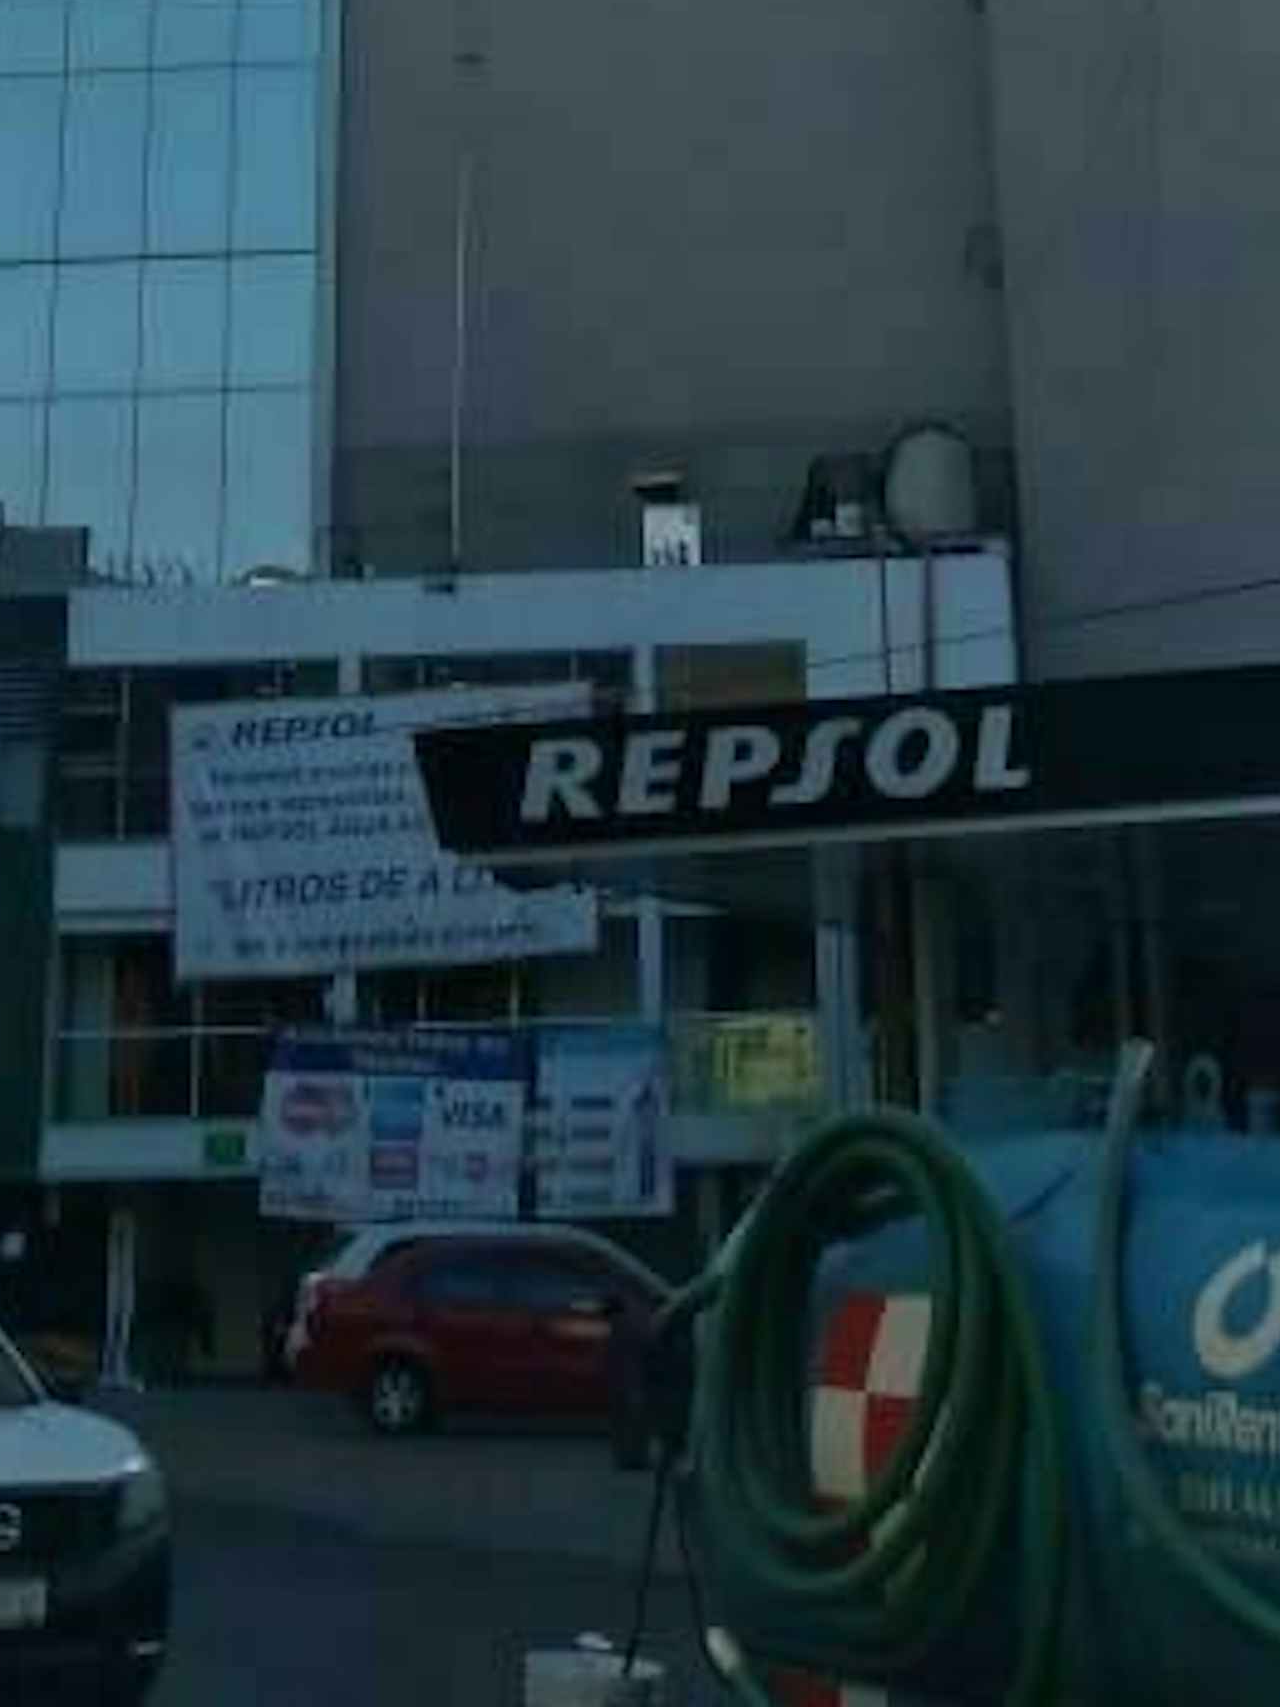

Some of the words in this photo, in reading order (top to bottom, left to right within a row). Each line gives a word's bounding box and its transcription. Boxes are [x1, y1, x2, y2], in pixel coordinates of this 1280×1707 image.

[232, 710, 375, 748] REPSOL
[521, 704, 1032, 823] REPSOL
[358, 866, 410, 900] DE
[417, 864, 441, 897] A
[441, 1101, 507, 1129] VISA
